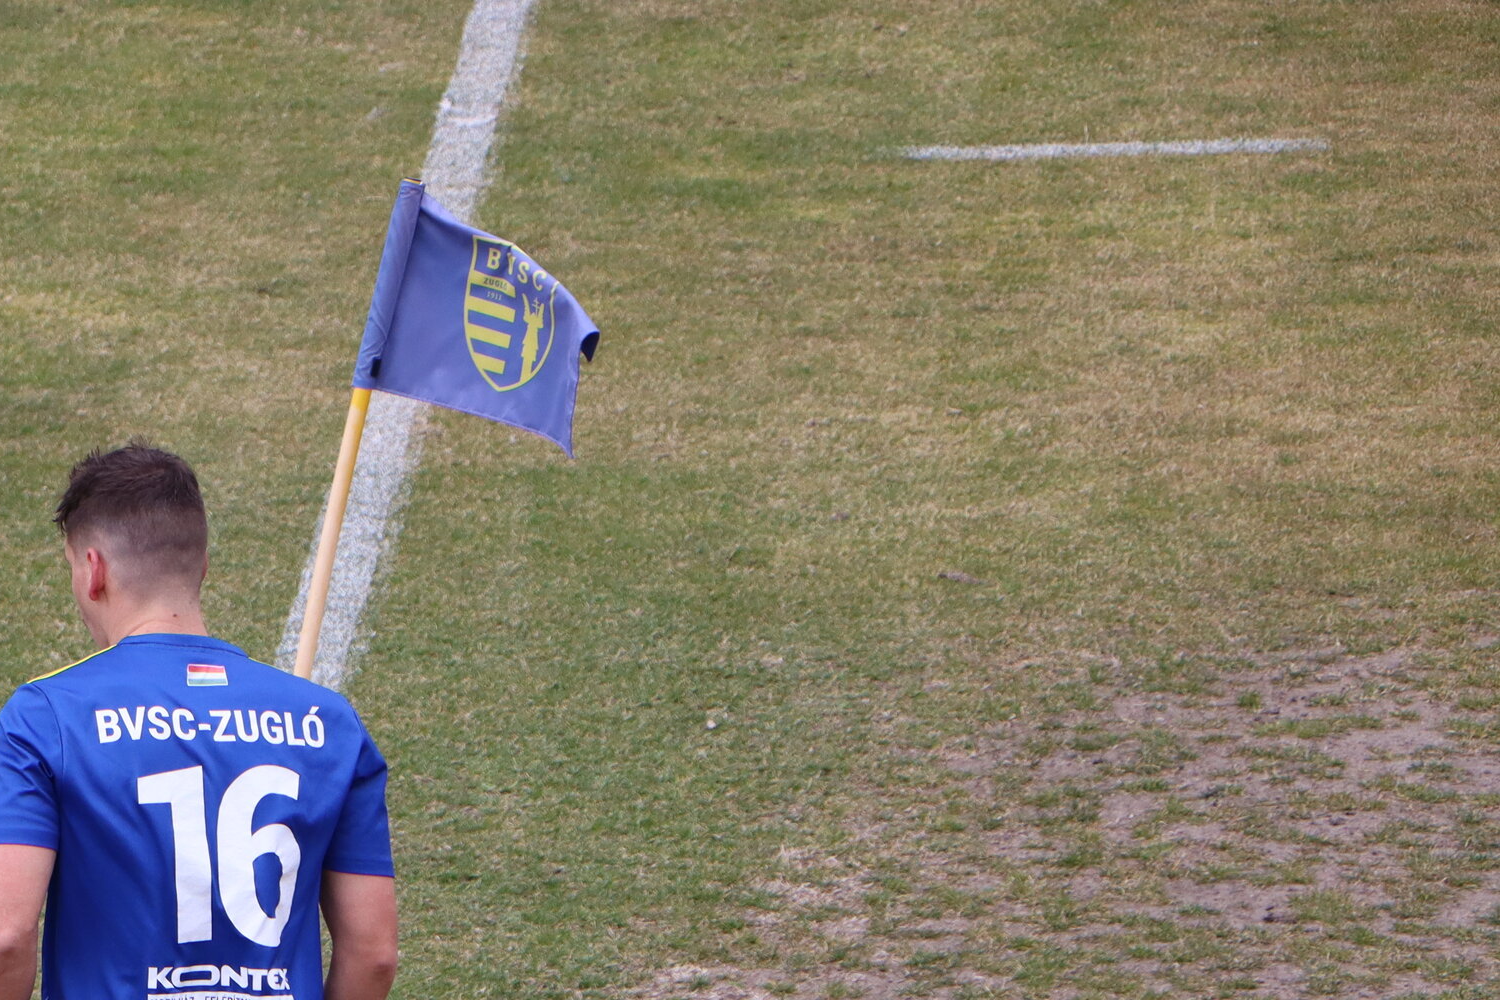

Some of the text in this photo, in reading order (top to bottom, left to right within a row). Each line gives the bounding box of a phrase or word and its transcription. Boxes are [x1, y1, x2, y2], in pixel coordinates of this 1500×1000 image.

[95, 705, 325, 748] BVSC-ZUGLÓ
[137, 764, 301, 947] 16
[147, 964, 290, 991] KONTEX
